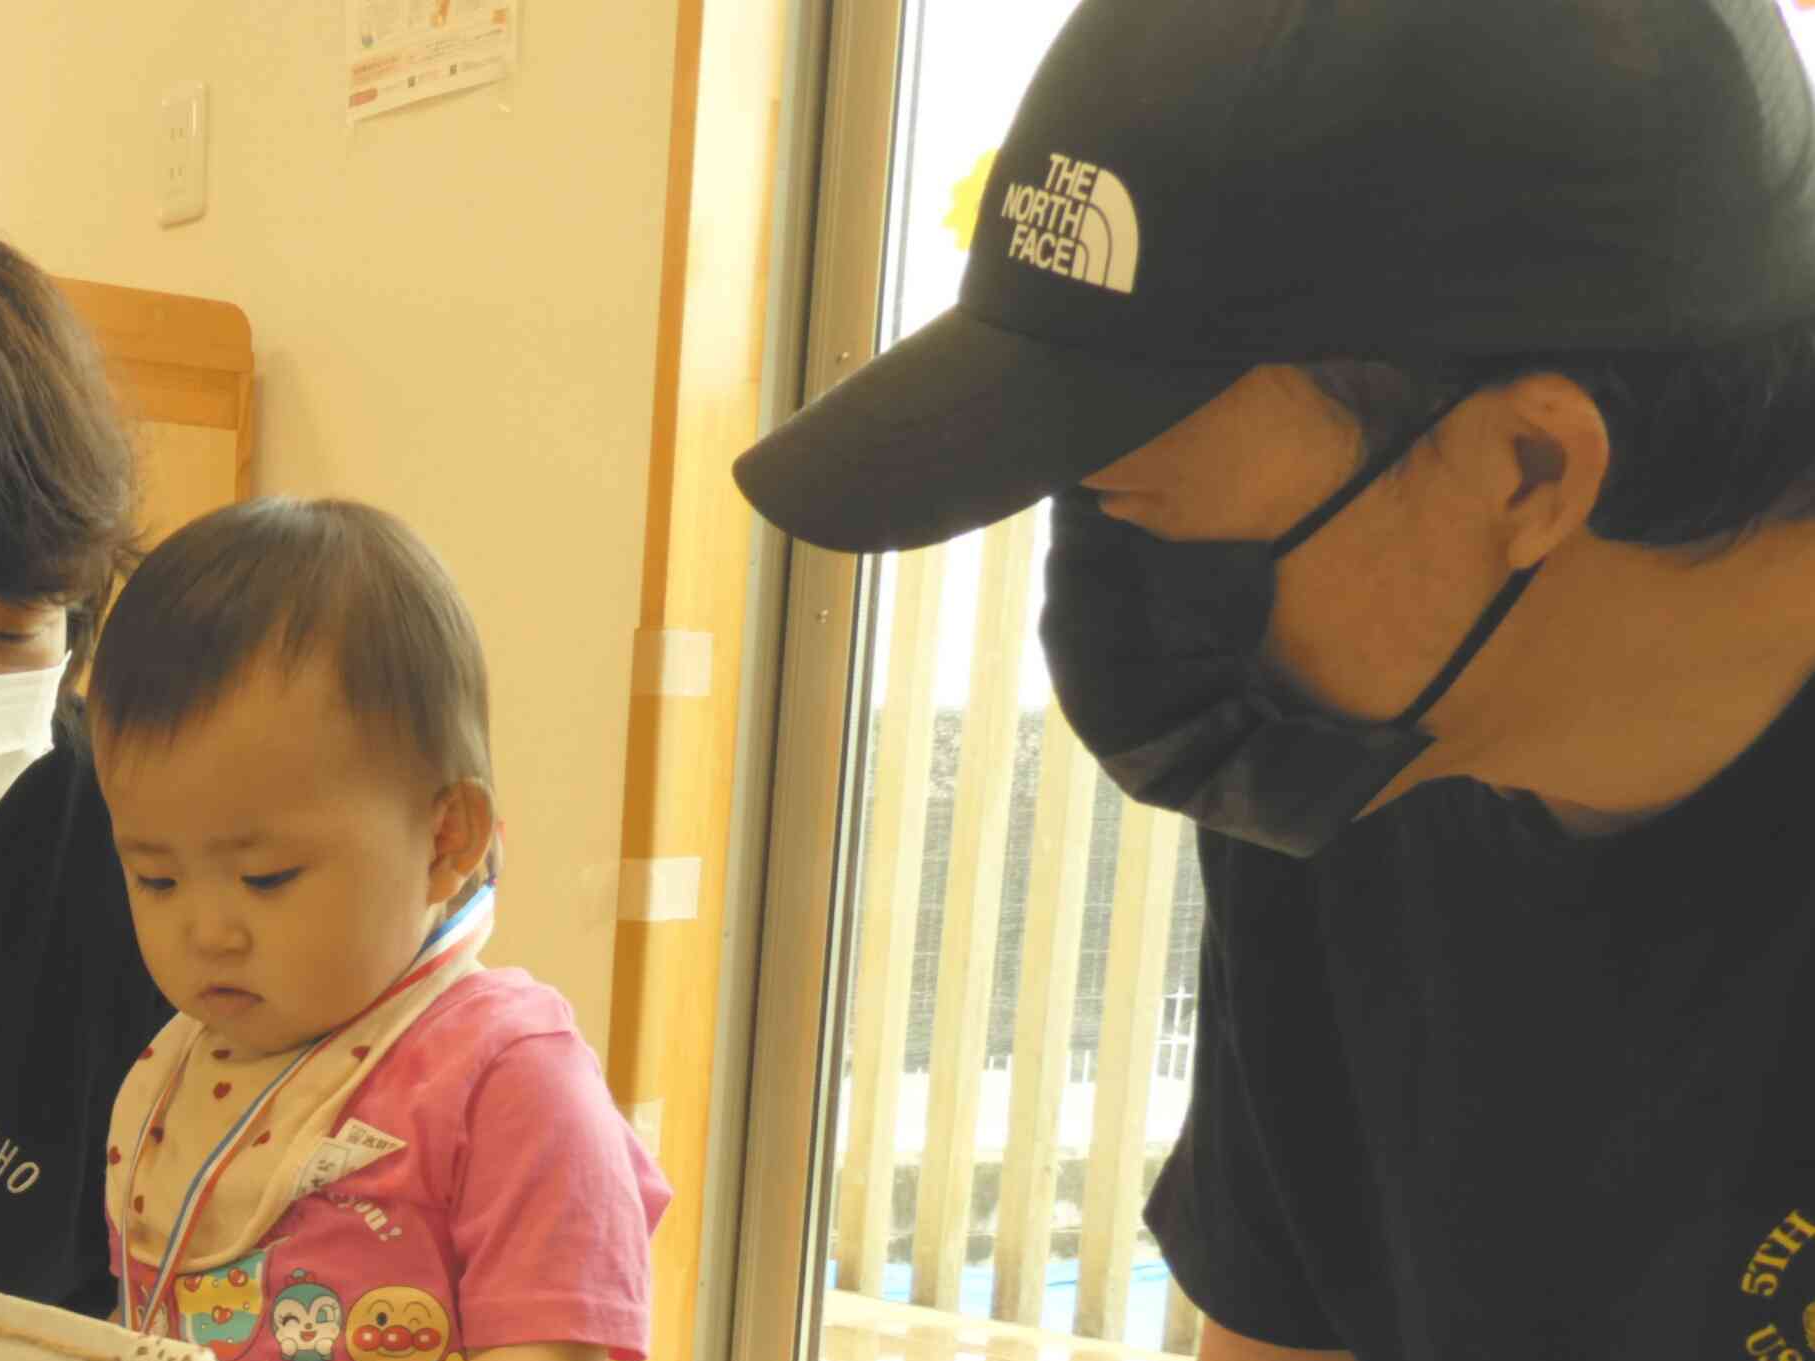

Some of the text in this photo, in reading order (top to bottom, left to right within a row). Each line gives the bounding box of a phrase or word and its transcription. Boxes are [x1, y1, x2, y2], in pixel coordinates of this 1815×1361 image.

[1045, 152, 1097, 200] THE
[1001, 183, 1085, 239] NORTH
[1008, 225, 1073, 275] FACE
